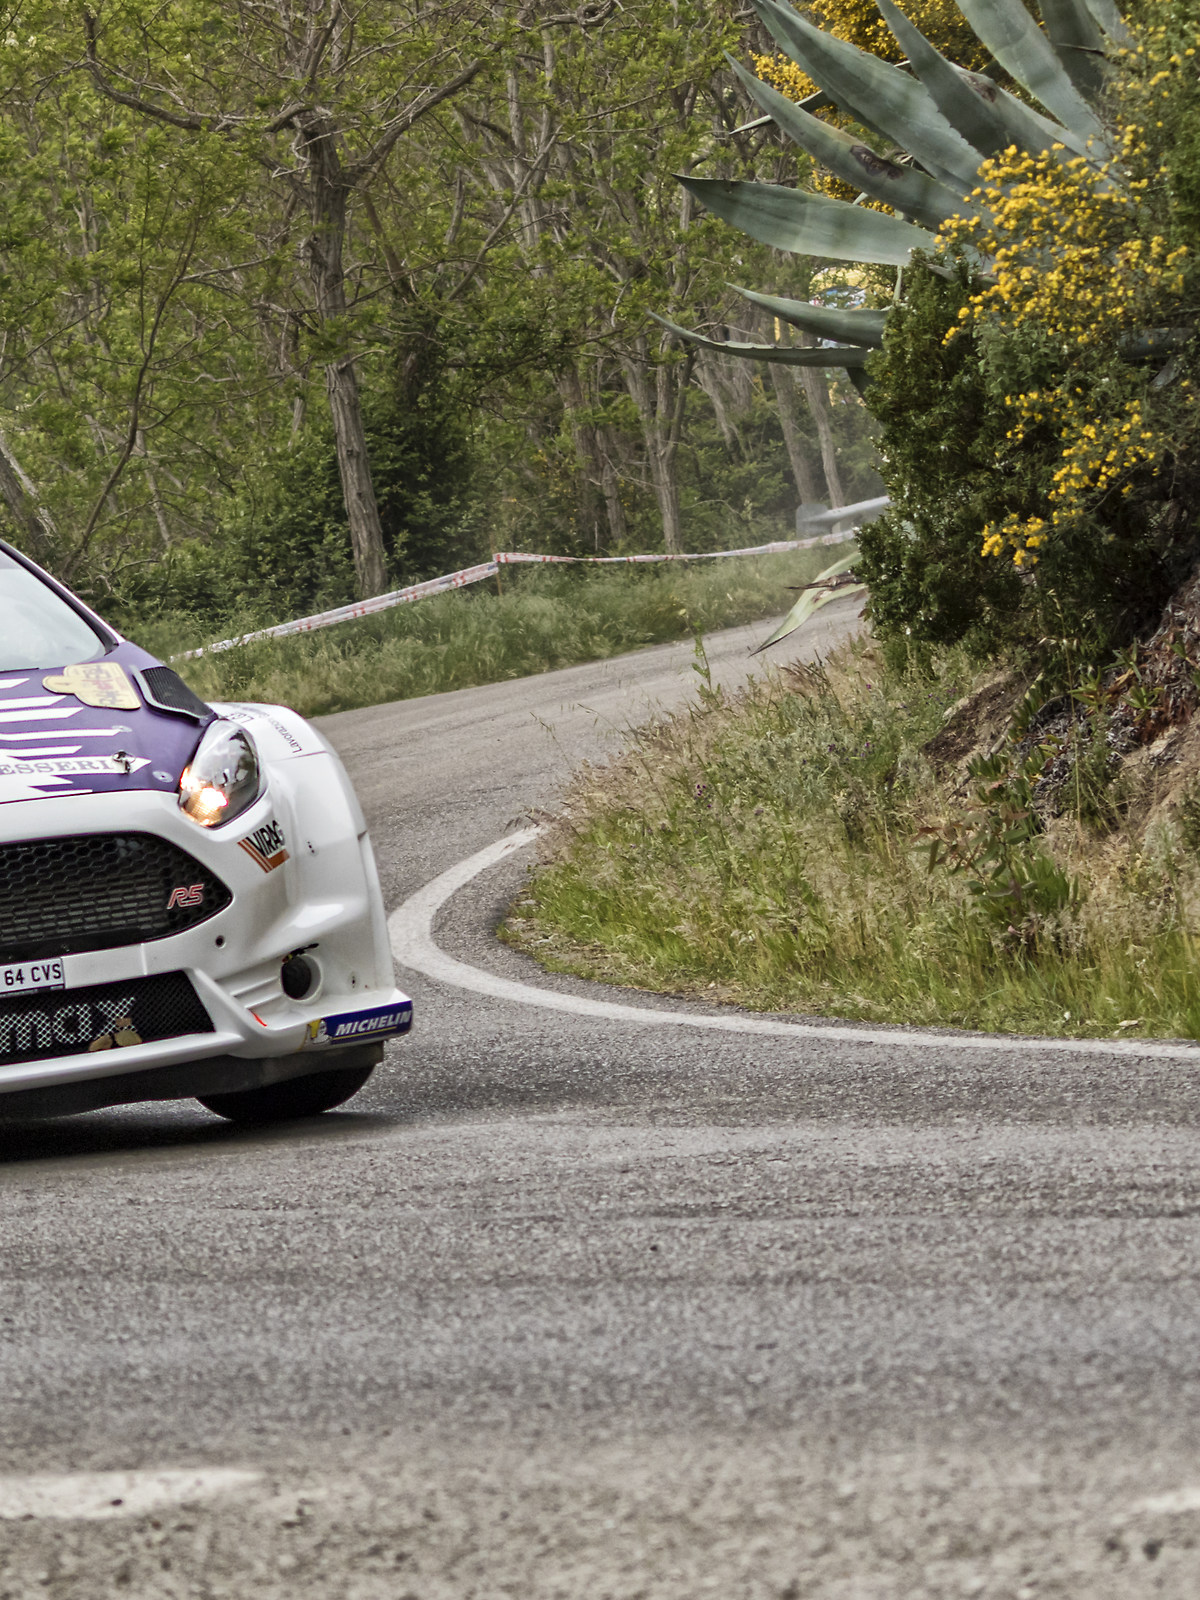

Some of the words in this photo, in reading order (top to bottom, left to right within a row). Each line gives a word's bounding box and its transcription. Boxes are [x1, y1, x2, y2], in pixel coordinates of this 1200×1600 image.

[245, 819, 286, 858] VIRAG
[4, 968, 25, 986] 64
[31, 963, 62, 982] CVS
[334, 1010, 413, 1037] MICHELIN
